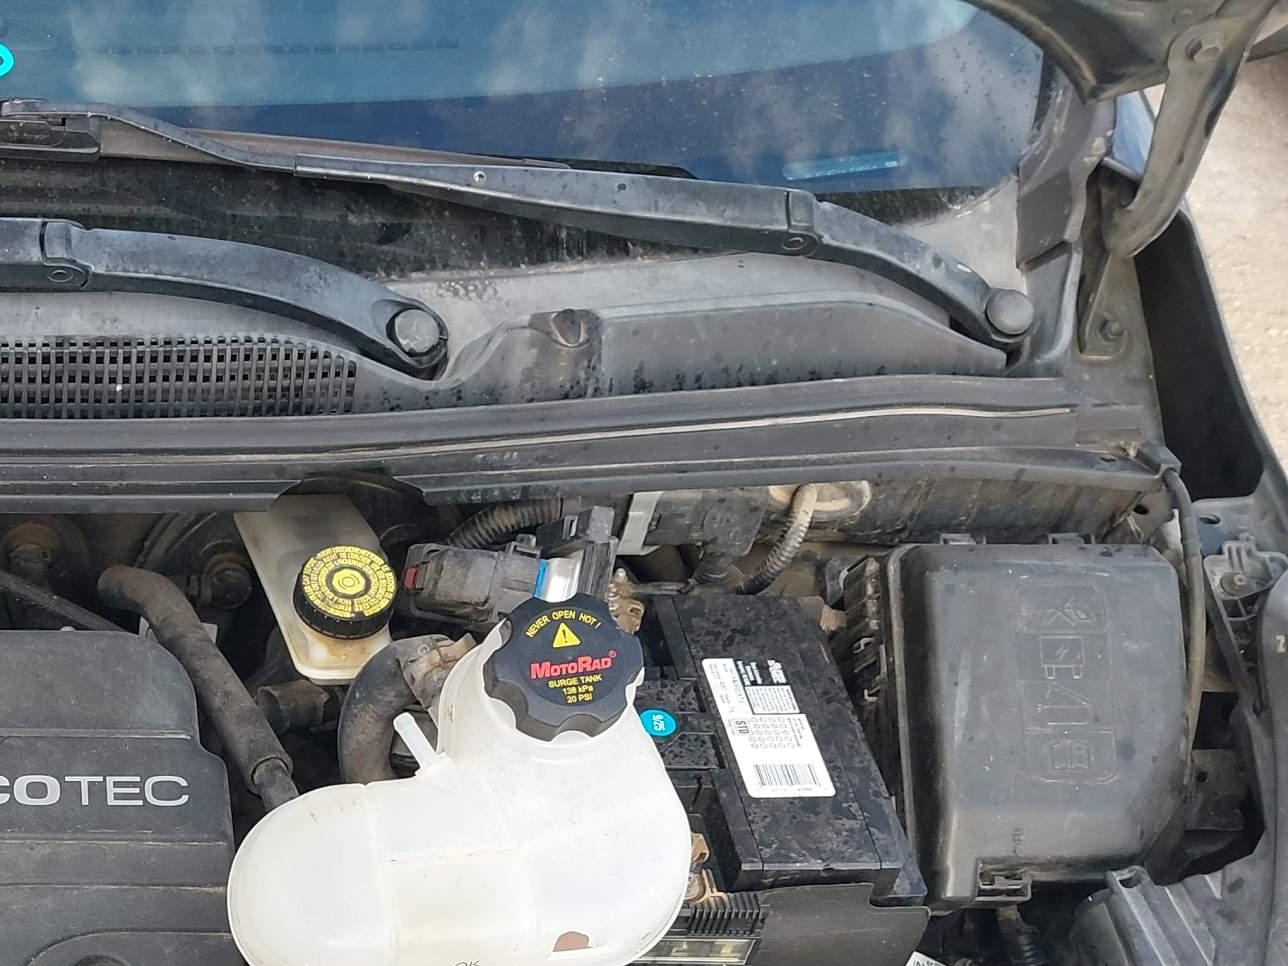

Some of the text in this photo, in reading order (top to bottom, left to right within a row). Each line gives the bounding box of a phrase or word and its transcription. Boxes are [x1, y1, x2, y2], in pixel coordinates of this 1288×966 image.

[526, 615, 550, 638] NEVER
[552, 610, 575, 620] OPEN
[548, 674, 602, 688] SURGE TANK
[578, 685, 594, 694] kPa
[567, 693, 593, 703] 20 PSI
